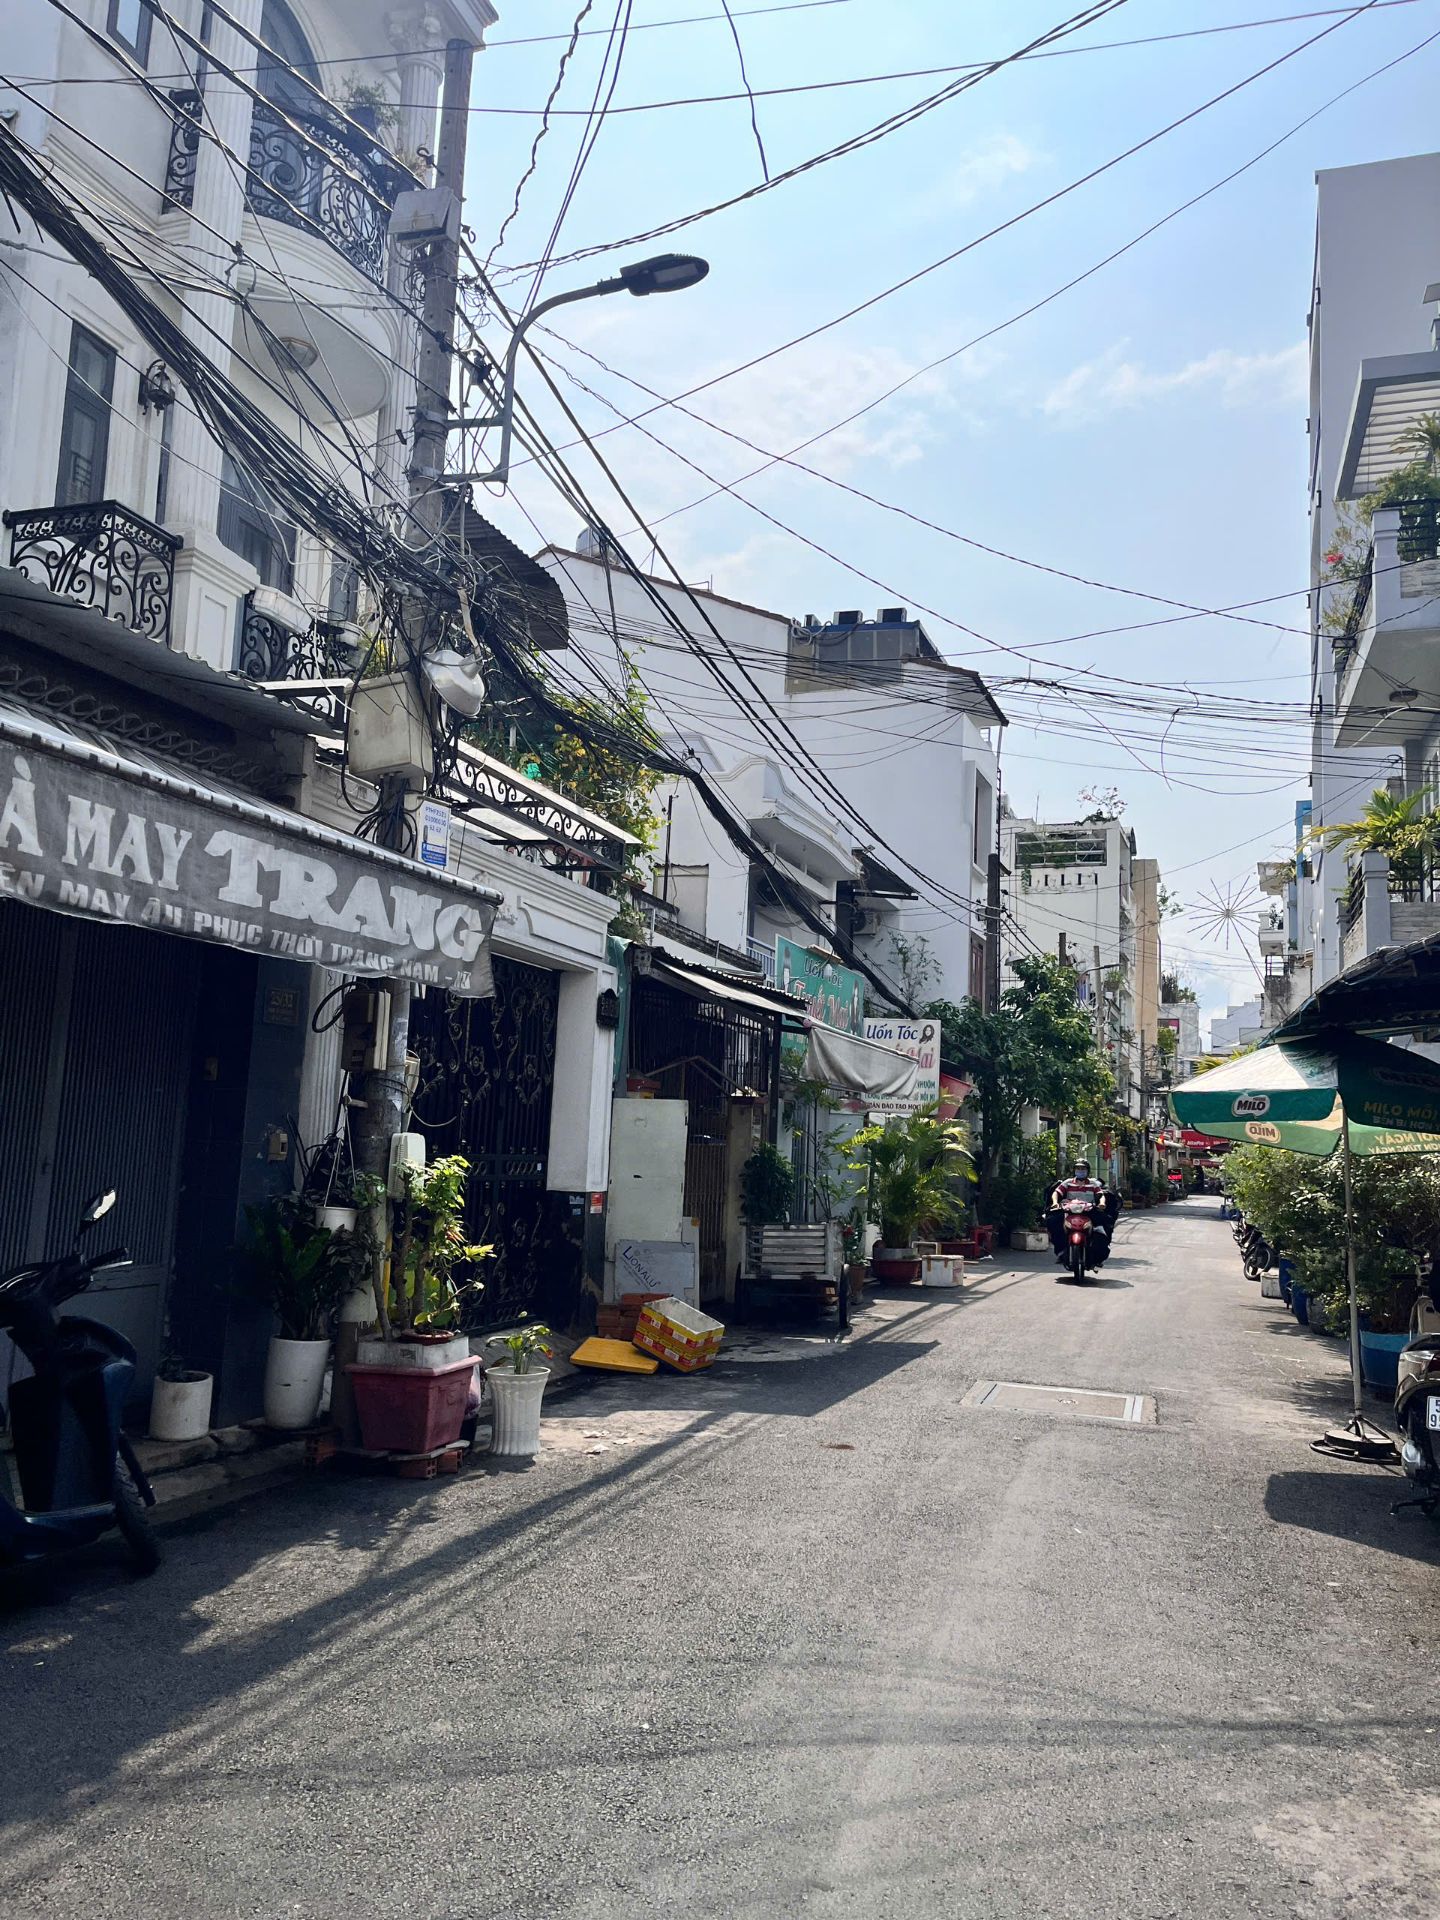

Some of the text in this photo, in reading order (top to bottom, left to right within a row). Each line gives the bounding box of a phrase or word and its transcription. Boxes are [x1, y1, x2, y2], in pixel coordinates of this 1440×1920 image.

[61, 795, 193, 891] MAY
[204, 830, 486, 962] TRANG
[59, 880, 131, 919] MAY
[193, 911, 263, 945] PHỤC
[269, 929, 323, 959] THỜI
[330, 943, 395, 971] TRANG
[400, 959, 439, 983] NAM
[866, 1023, 919, 1040] Uốn Tóc
[1237, 1100, 1266, 1111] MILO
